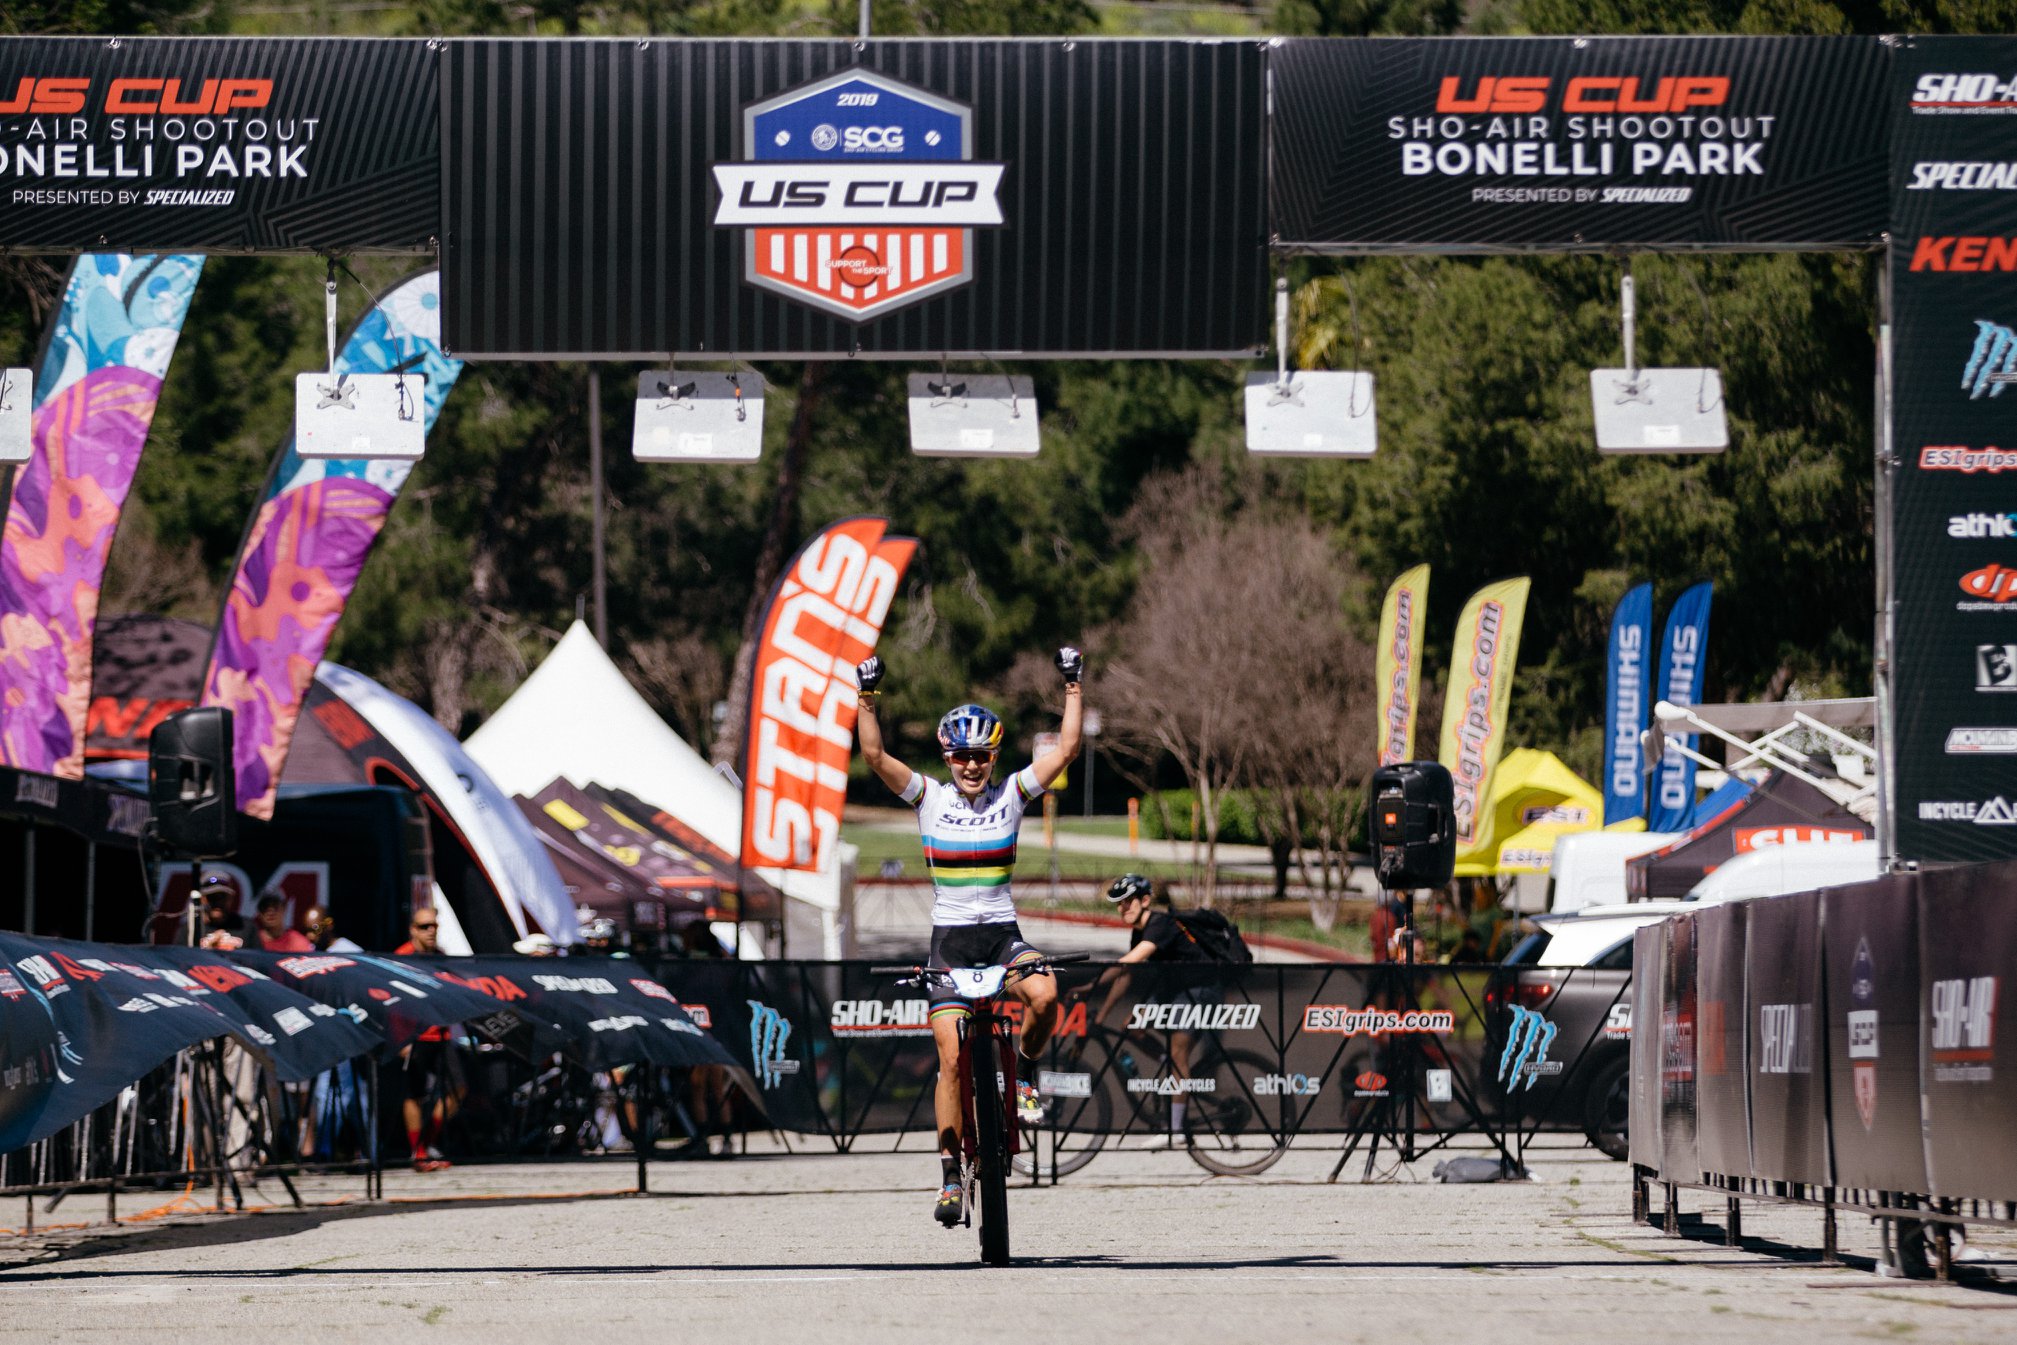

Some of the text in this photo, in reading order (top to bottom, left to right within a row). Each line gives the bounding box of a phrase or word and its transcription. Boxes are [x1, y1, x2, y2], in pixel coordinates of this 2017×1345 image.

[104, 78, 274, 114] CUP
[1435, 76, 1731, 113] US CUP
[0, 118, 319, 141] -AIR SHOOTOUT
[843, 125, 905, 148] SCG
[1387, 115, 1776, 140] SHO-AIR SHOOTOUT
[177, 144, 308, 177] PARK
[1401, 142, 1764, 176] BONELLI PARK
[13, 189, 235, 206] PRESENTED BY SPECIALIZED
[738, 180, 979, 208] US CUP
[1471, 186, 1693, 203] PRESENTED BY SPECIALIZED
[825, 259, 867, 268] SUPPORT
[863, 266, 893, 275] SPORT
[1612, 624, 1642, 798] SHIMANO
[1660, 624, 1698, 810] SHINO
[939, 803, 1009, 826] SCOTT
[1918, 802, 1977, 819] INCYCLE
[830, 999, 930, 1026] SHO-AIR
[1127, 1003, 1262, 1030] SPECIALIZED
[1306, 1008, 1451, 1033] ESIgrips.com
